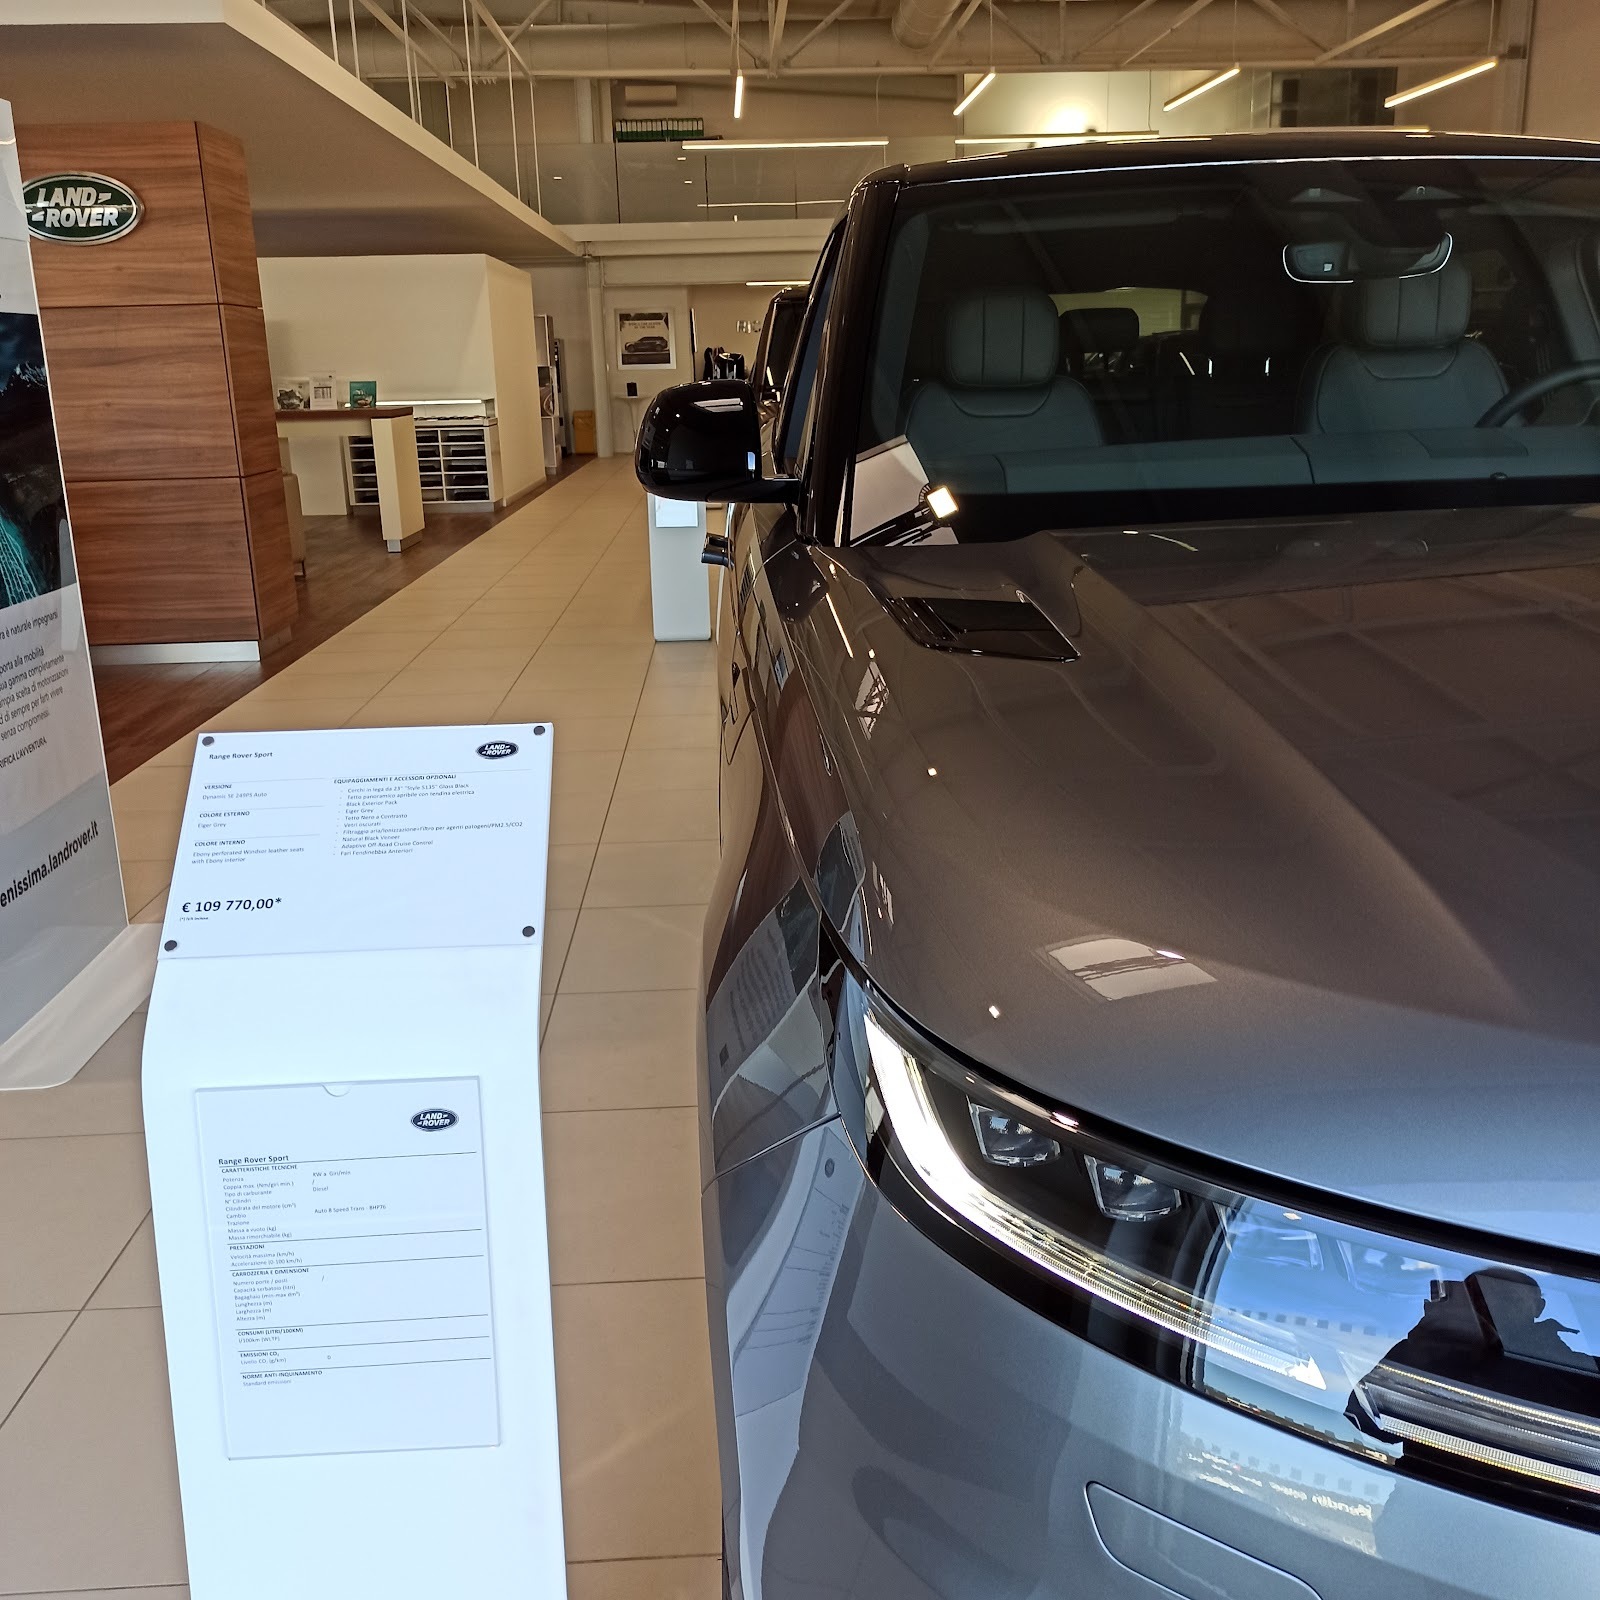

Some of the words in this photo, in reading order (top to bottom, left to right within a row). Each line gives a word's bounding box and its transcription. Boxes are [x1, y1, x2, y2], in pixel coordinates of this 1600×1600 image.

[37, 187, 97, 207] LAND
[45, 207, 118, 228] ROVER
[10, 619, 31, 636] naturale
[14, 654, 23, 667] alla
[24, 646, 45, 664] mobilità
[8, 671, 28, 690] gamma
[28, 654, 64, 677] completamente
[16, 684, 31, 701] scelta
[10, 702, 31, 720] sempre
[31, 698, 39, 712] per
[50, 686, 63, 699] vivere
[0, 725, 17, 741] senza
[0, 820, 98, 908] enissima.landrover.it
[182, 902, 191, 912] €
[195, 901, 221, 912] 109
[422, 1119, 450, 1127] ROVER
[268, 1155, 289, 1163] Sport
